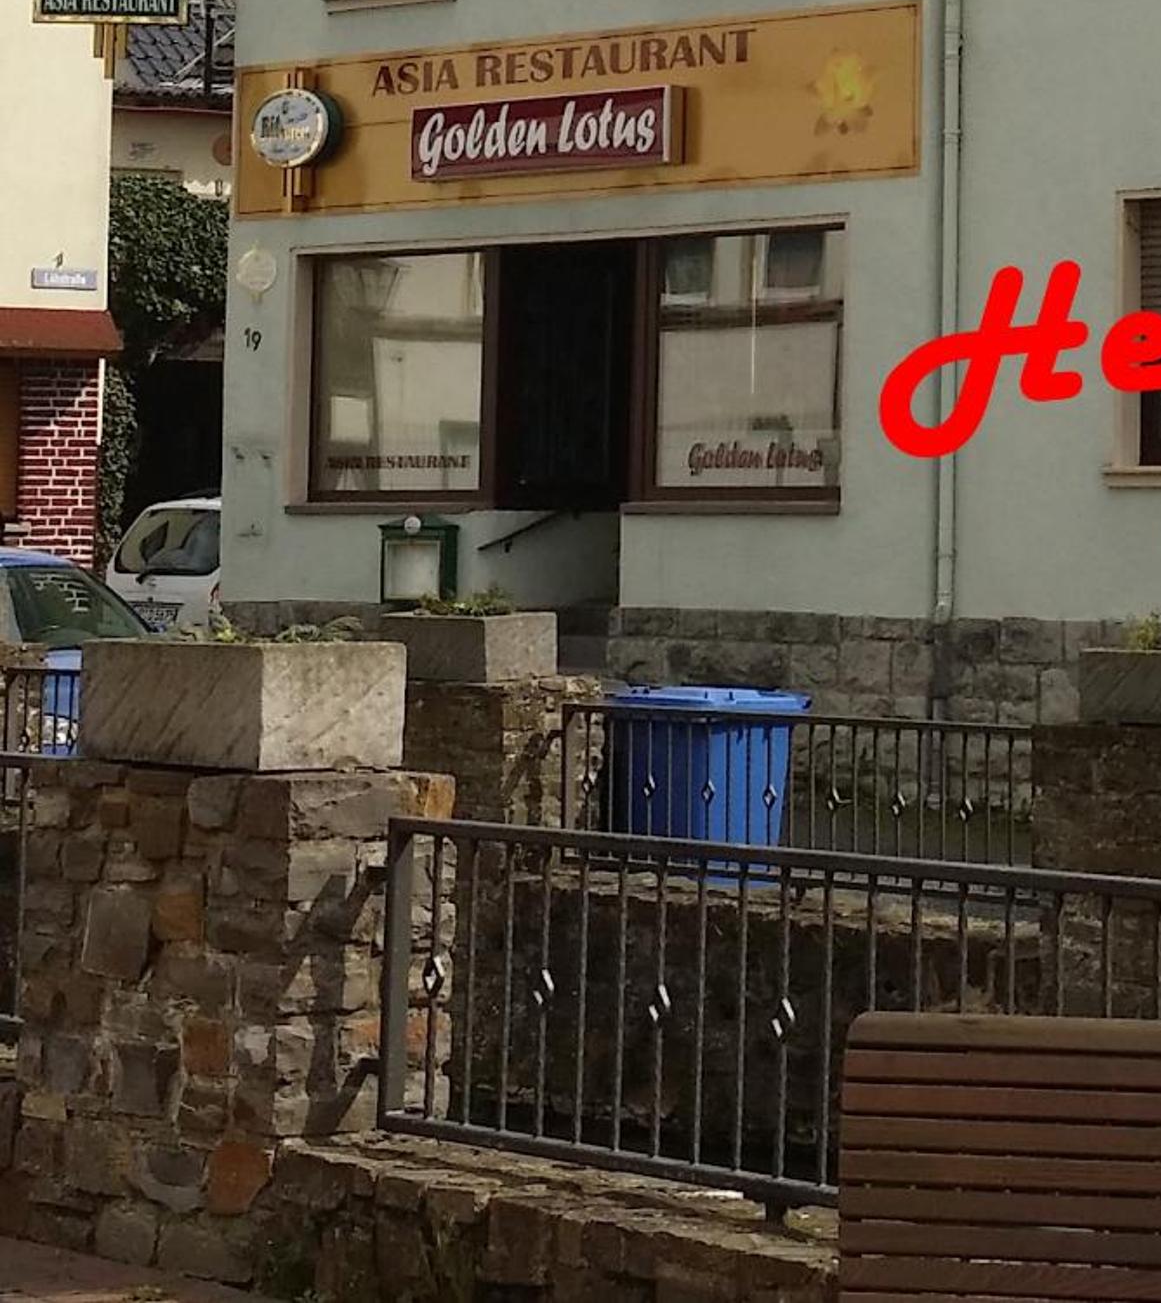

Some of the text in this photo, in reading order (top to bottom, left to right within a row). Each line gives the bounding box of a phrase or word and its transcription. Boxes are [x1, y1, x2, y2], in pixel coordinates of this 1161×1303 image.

[372, 28, 757, 97] ASIA RESTAURANT
[418, 98, 656, 176] Golden Lotus
[244, 327, 262, 351] 19
[365, 454, 470, 469] RESTAURANT
